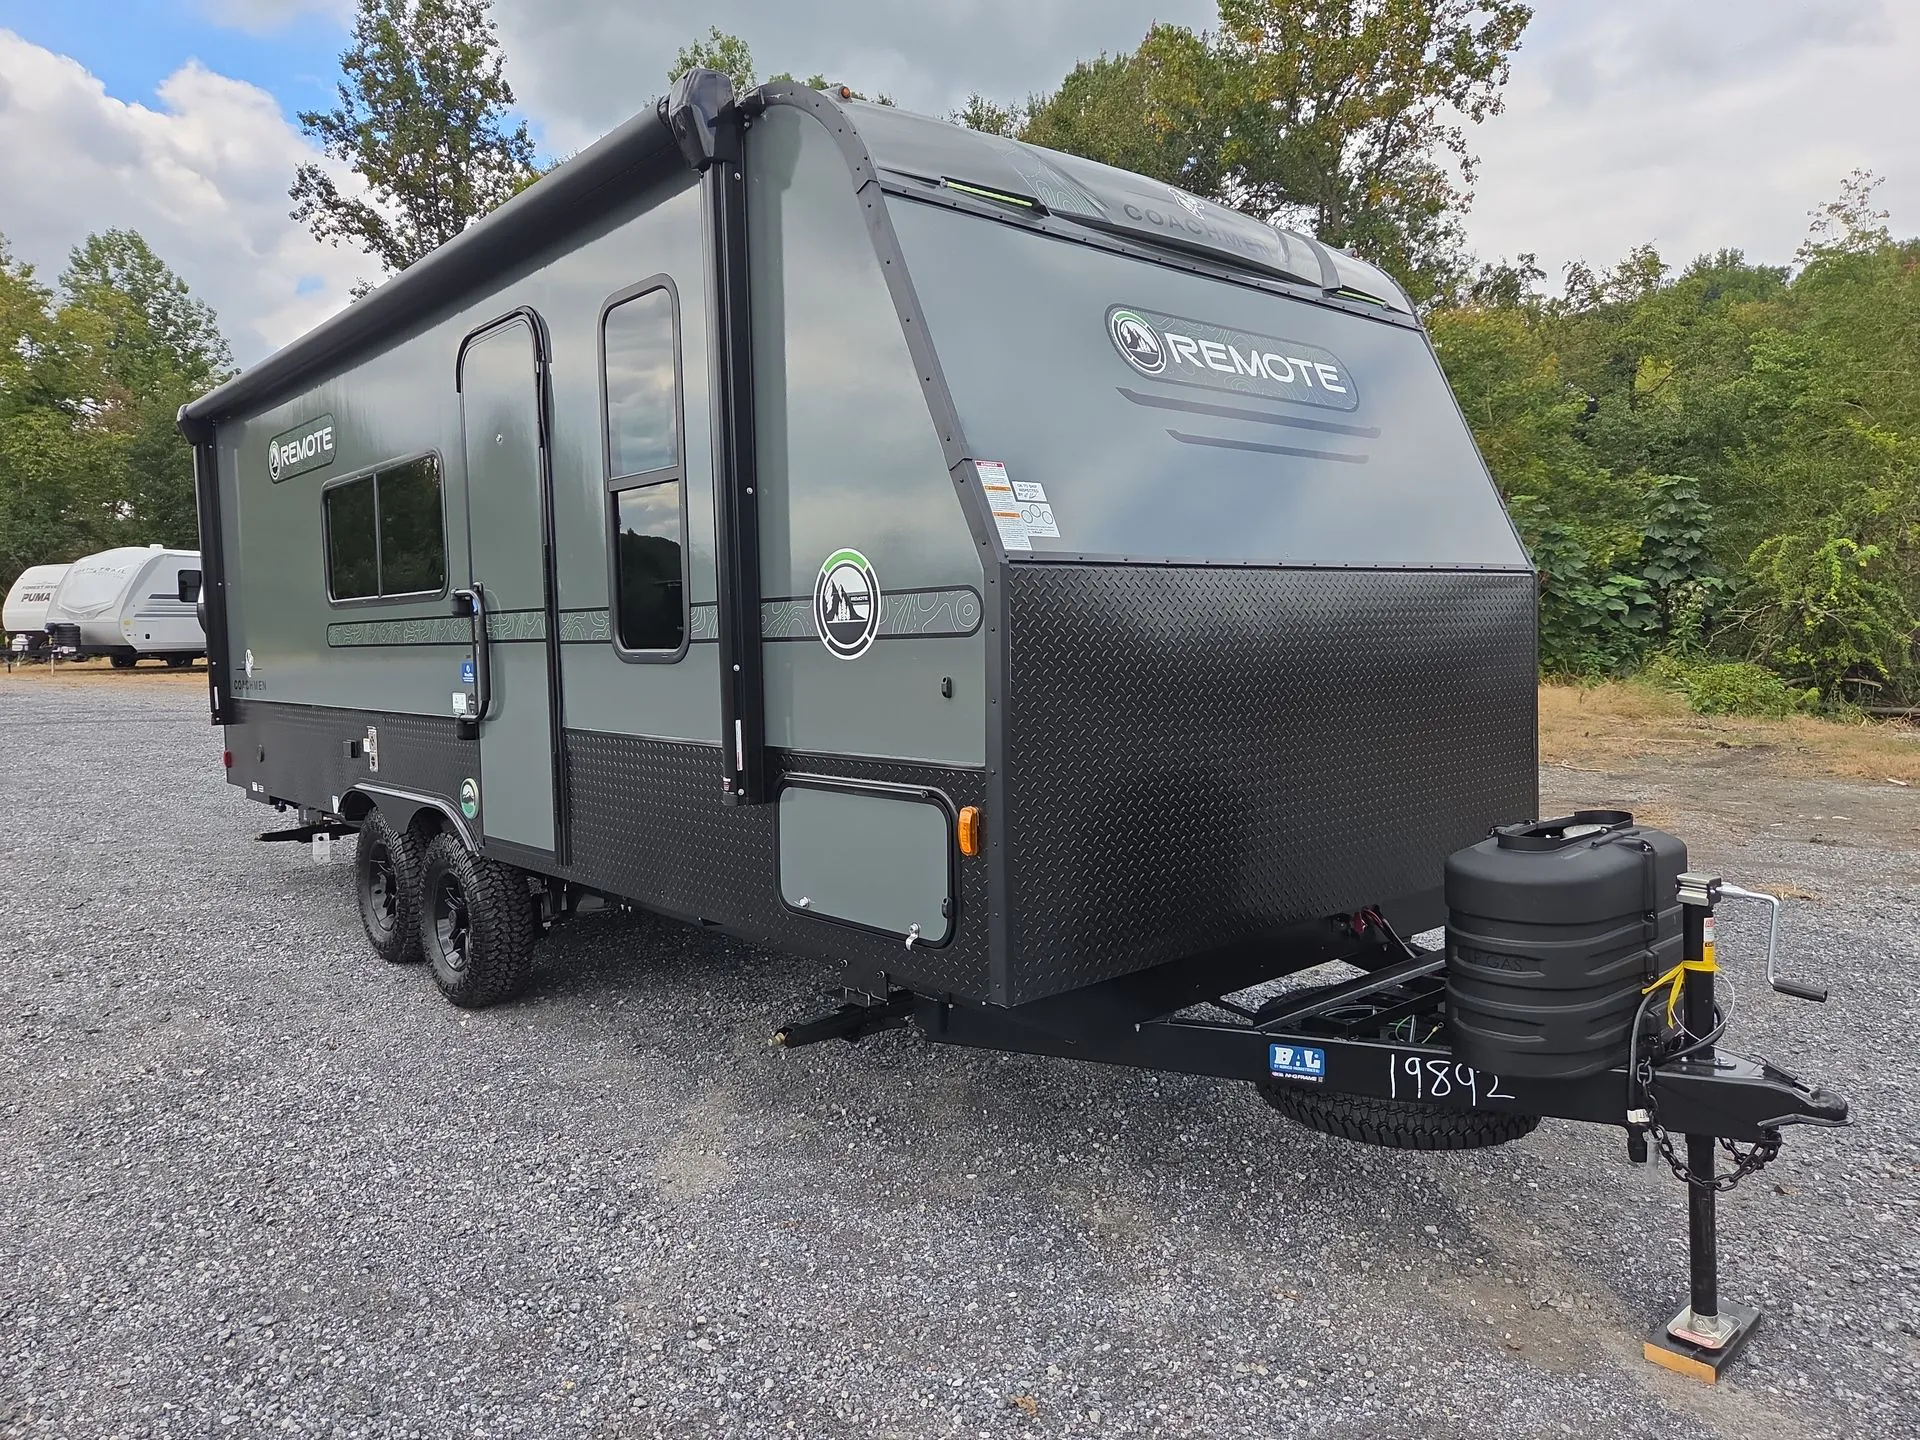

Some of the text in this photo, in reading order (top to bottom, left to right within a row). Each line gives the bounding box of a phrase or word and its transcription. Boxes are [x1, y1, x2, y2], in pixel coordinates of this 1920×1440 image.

[1123, 203, 1273, 256] COACHMEN
[1164, 332, 1347, 393] REMOTE
[280, 426, 333, 467] REMOTE
[21, 592, 51, 603] PUMA
[233, 680, 267, 691] COACHMEN
[1486, 955, 1522, 971] GAS
